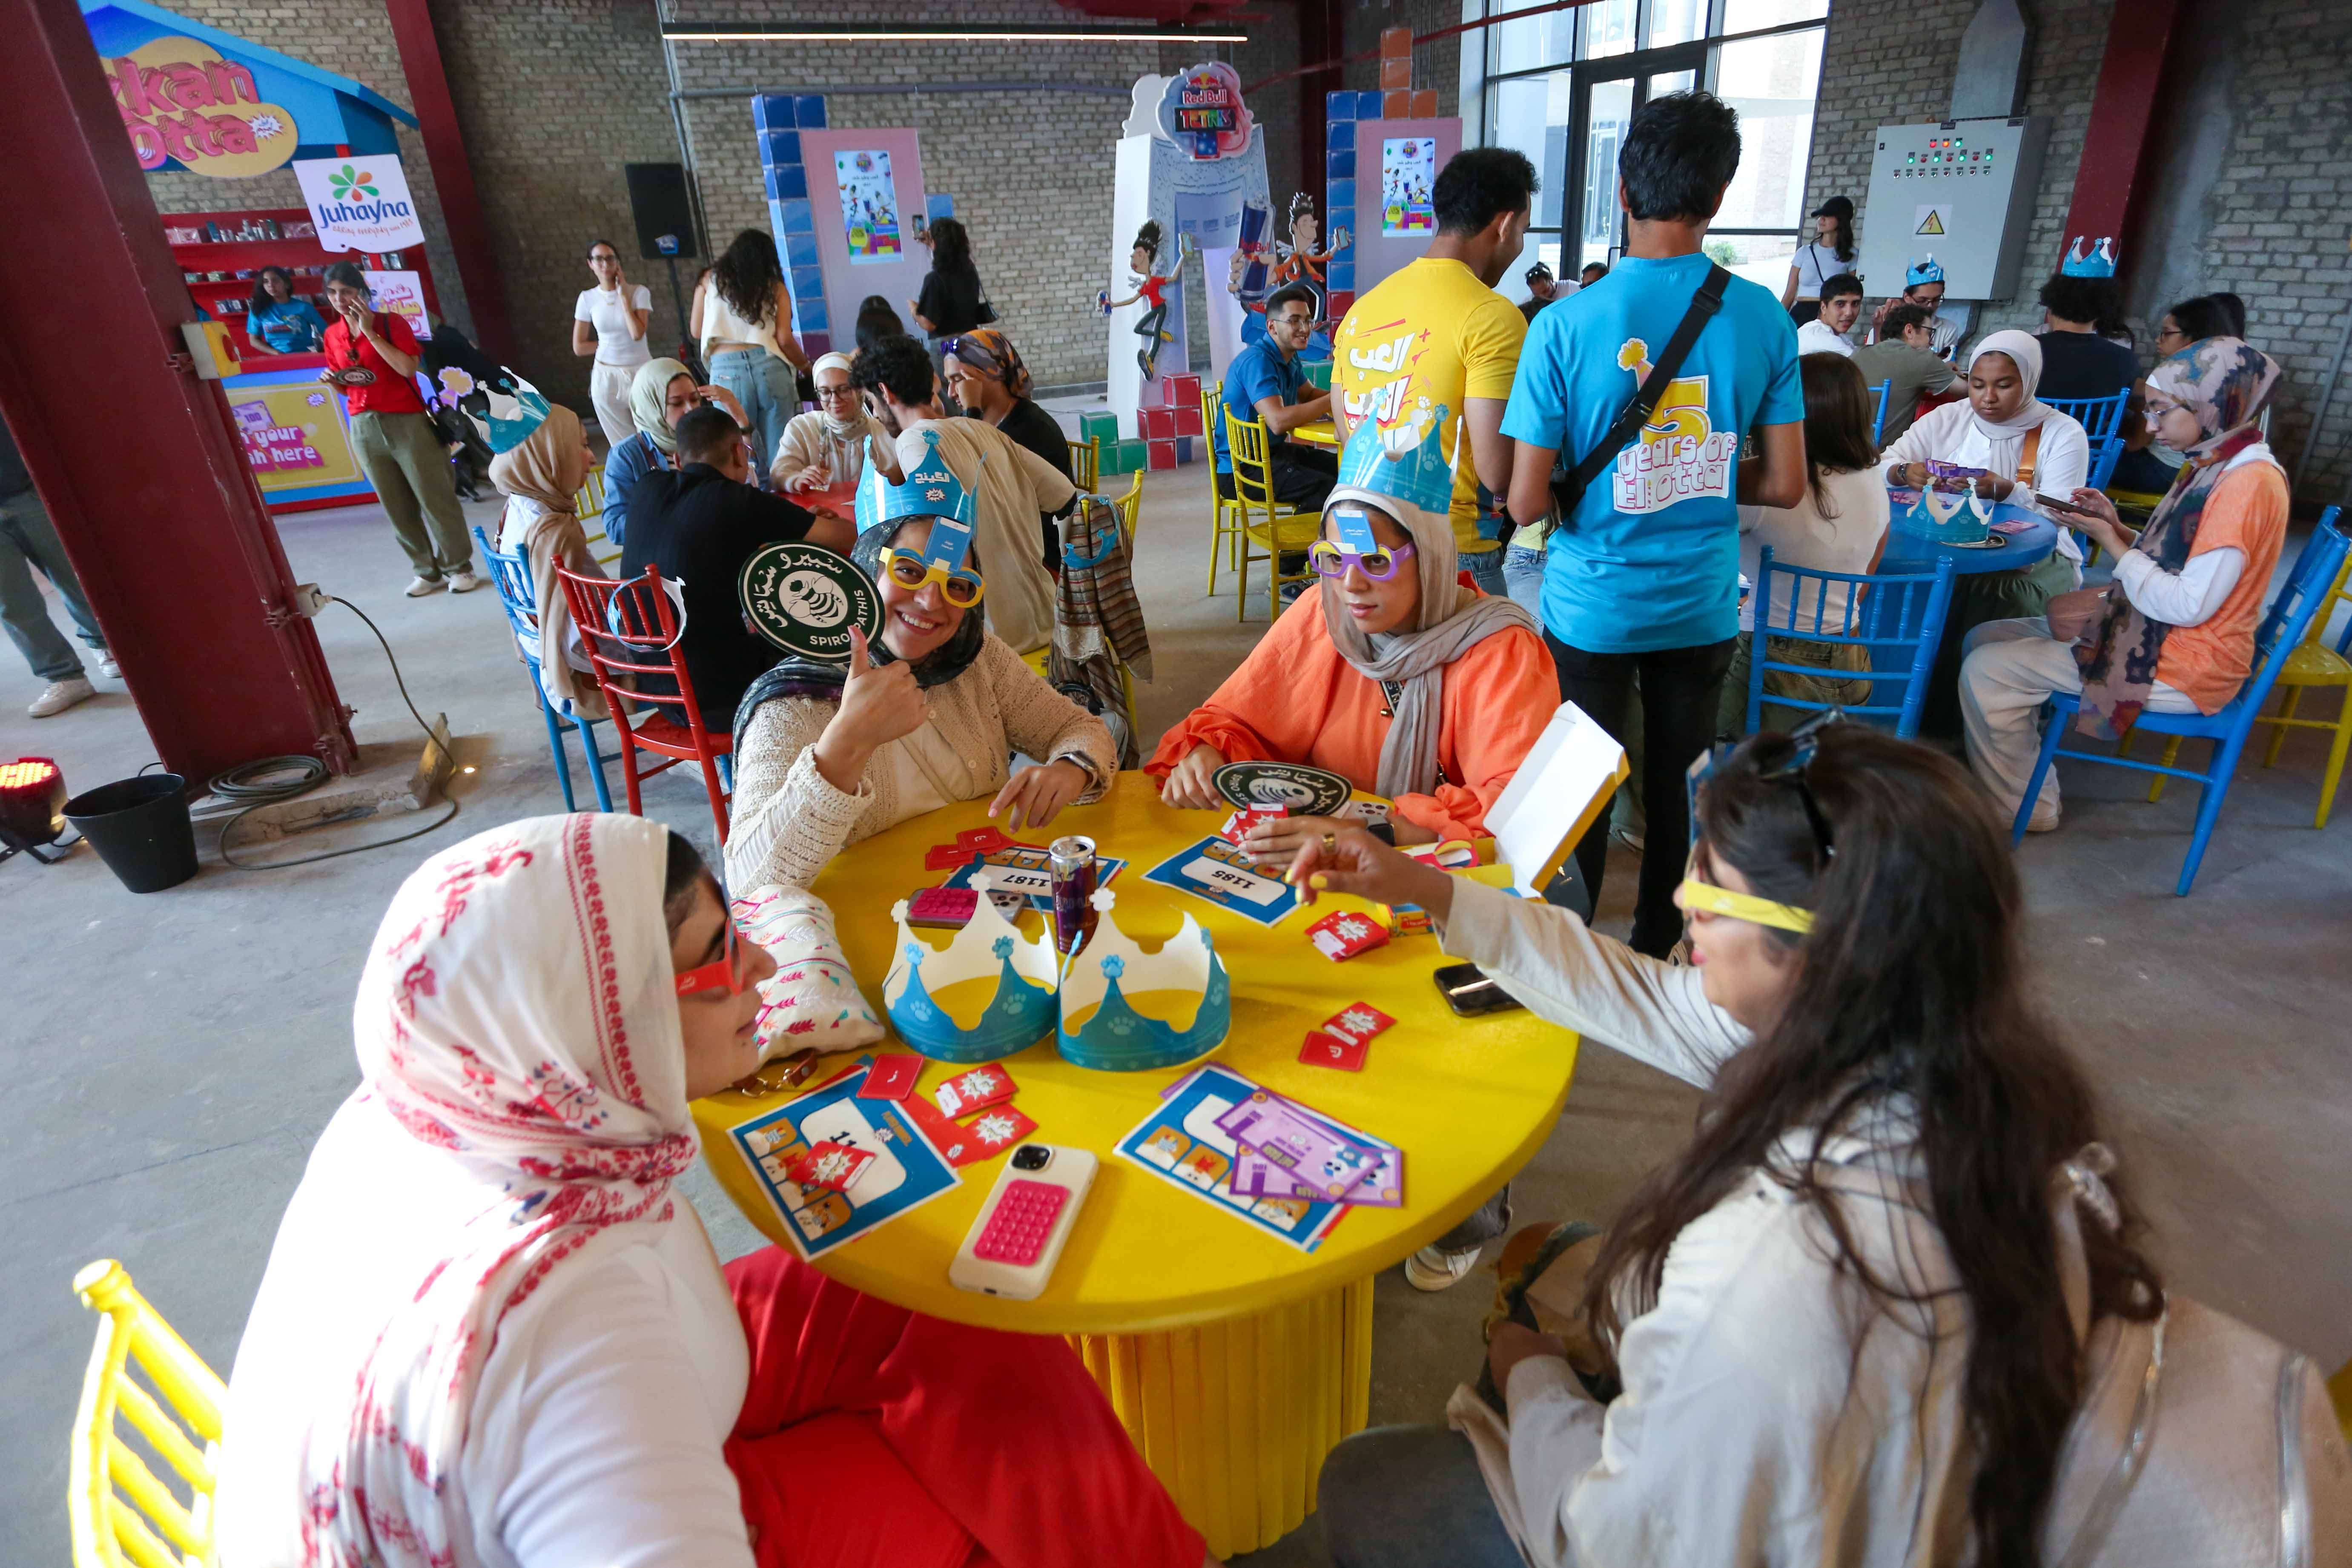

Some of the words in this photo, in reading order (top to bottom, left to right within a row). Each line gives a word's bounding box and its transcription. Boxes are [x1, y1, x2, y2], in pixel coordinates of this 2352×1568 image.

[1182, 90, 1205, 104] Red
[1206, 89, 1227, 103] Bull
[1180, 109, 1232, 129] TETRIS
[318, 199, 410, 229] Juhayna
[255, 427, 298, 447] your
[270, 446, 316, 462] here
[1620, 434, 1697, 483] years
[1705, 434, 1736, 462] of
[915, 471, 950, 484] الكينج
[1616, 476, 1646, 509] El
[1656, 461, 1724, 502] otta
[809, 633, 850, 646] SPIRO
[853, 589, 869, 630] PATHIS
[1002, 874, 1050, 887] 1187
[1211, 870, 1256, 889] 1185
